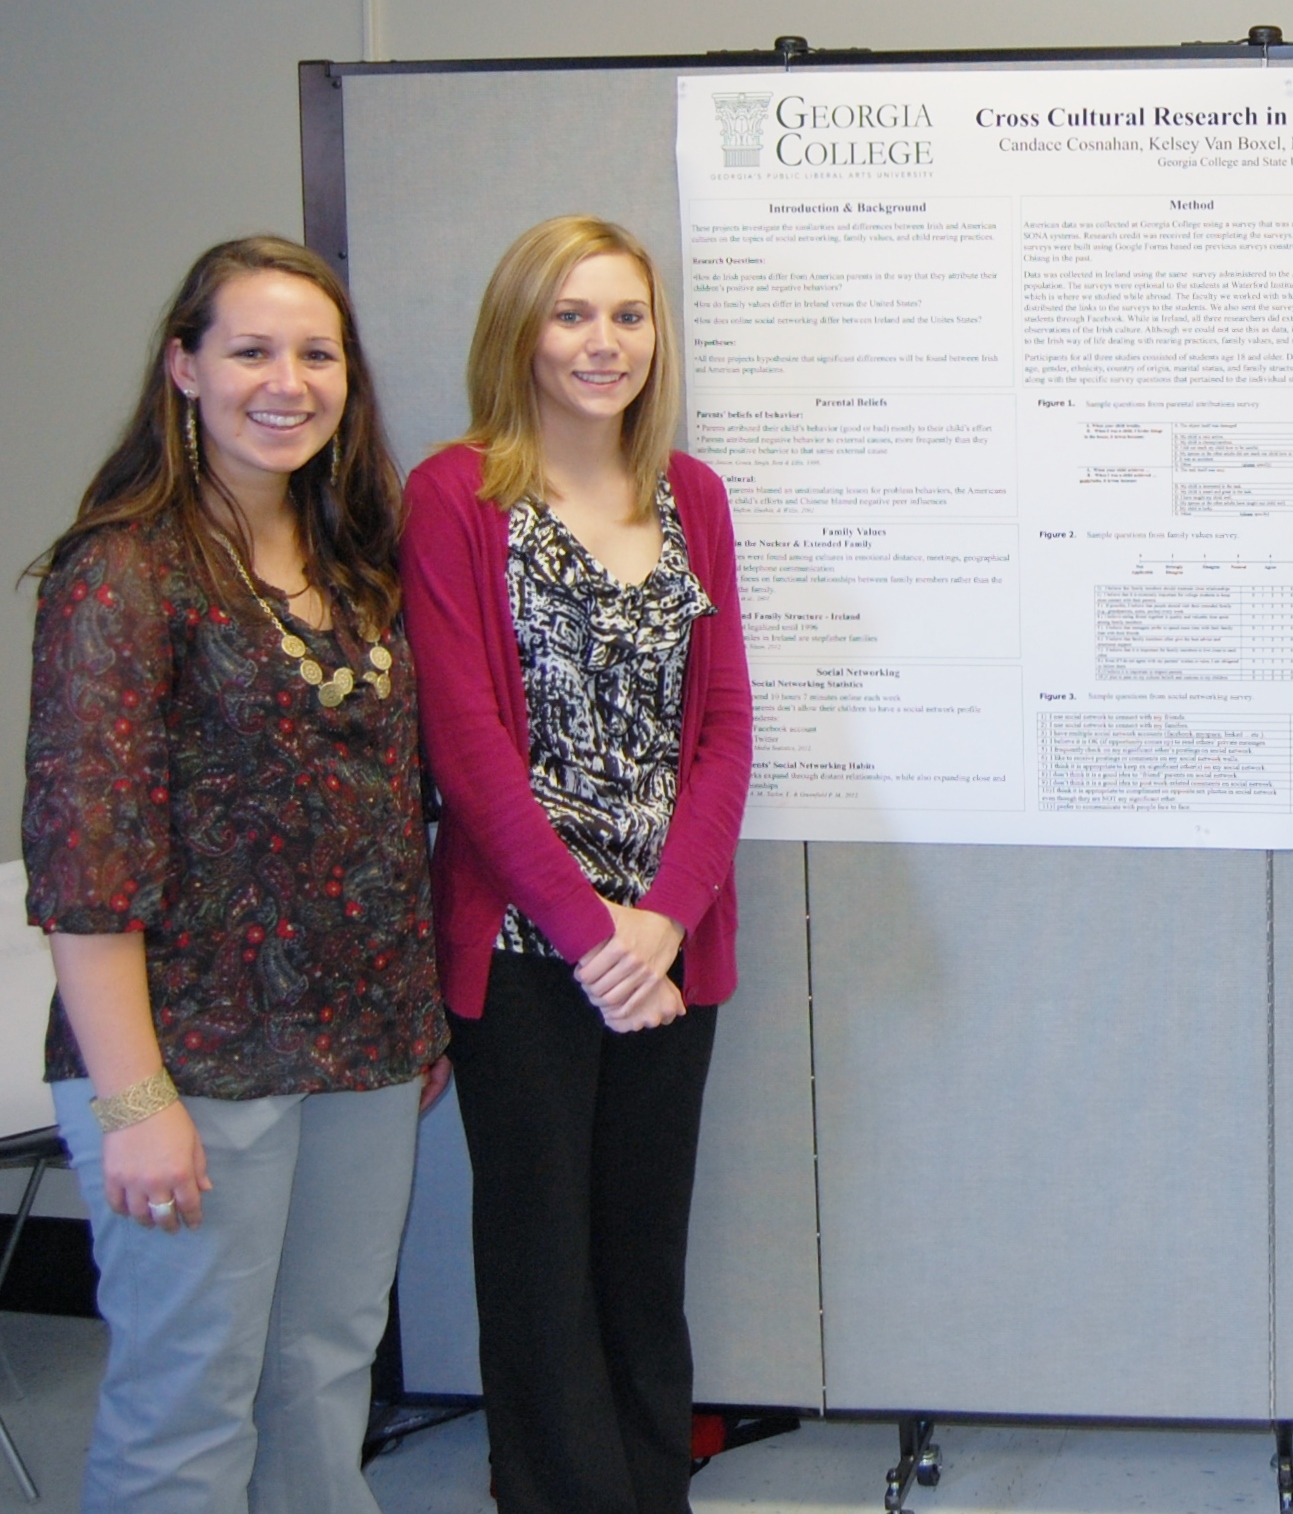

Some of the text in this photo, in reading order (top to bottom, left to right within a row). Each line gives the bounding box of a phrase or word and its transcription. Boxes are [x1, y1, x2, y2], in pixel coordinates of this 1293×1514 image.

[775, 96, 934, 129] GEORGIA
[976, 109, 1039, 127] Cross
[1047, 108, 1145, 126] Cultural
[1154, 107, 1257, 125] Research
[1266, 107, 1287, 125] in
[999, 138, 1062, 151] Candace
[1066, 138, 1143, 151] Cosnahan,
[1149, 137, 1199, 153] Kelsey
[1205, 137, 1233, 150] Van
[1238, 136, 1286, 150] Boxel,
[775, 133, 934, 167] COLLEGE
[1157, 157, 1198, 169] Georgia
[1199, 157, 1239, 169] College
[1241, 157, 1260, 166] and
[1262, 157, 1288, 166] State
[768, 203, 927, 213] Introduction & Background
[1169, 200, 1215, 210] Method
[857, 398, 888, 406] Beliefs
[1037, 400, 1065, 408] Figure
[1039, 531, 1067, 539] Figure
[816, 668, 901, 677] Social Networking
[777, 680, 825, 689] Networking
[1039, 693, 1067, 701] Figure
[799, 762, 847, 770] Networking
